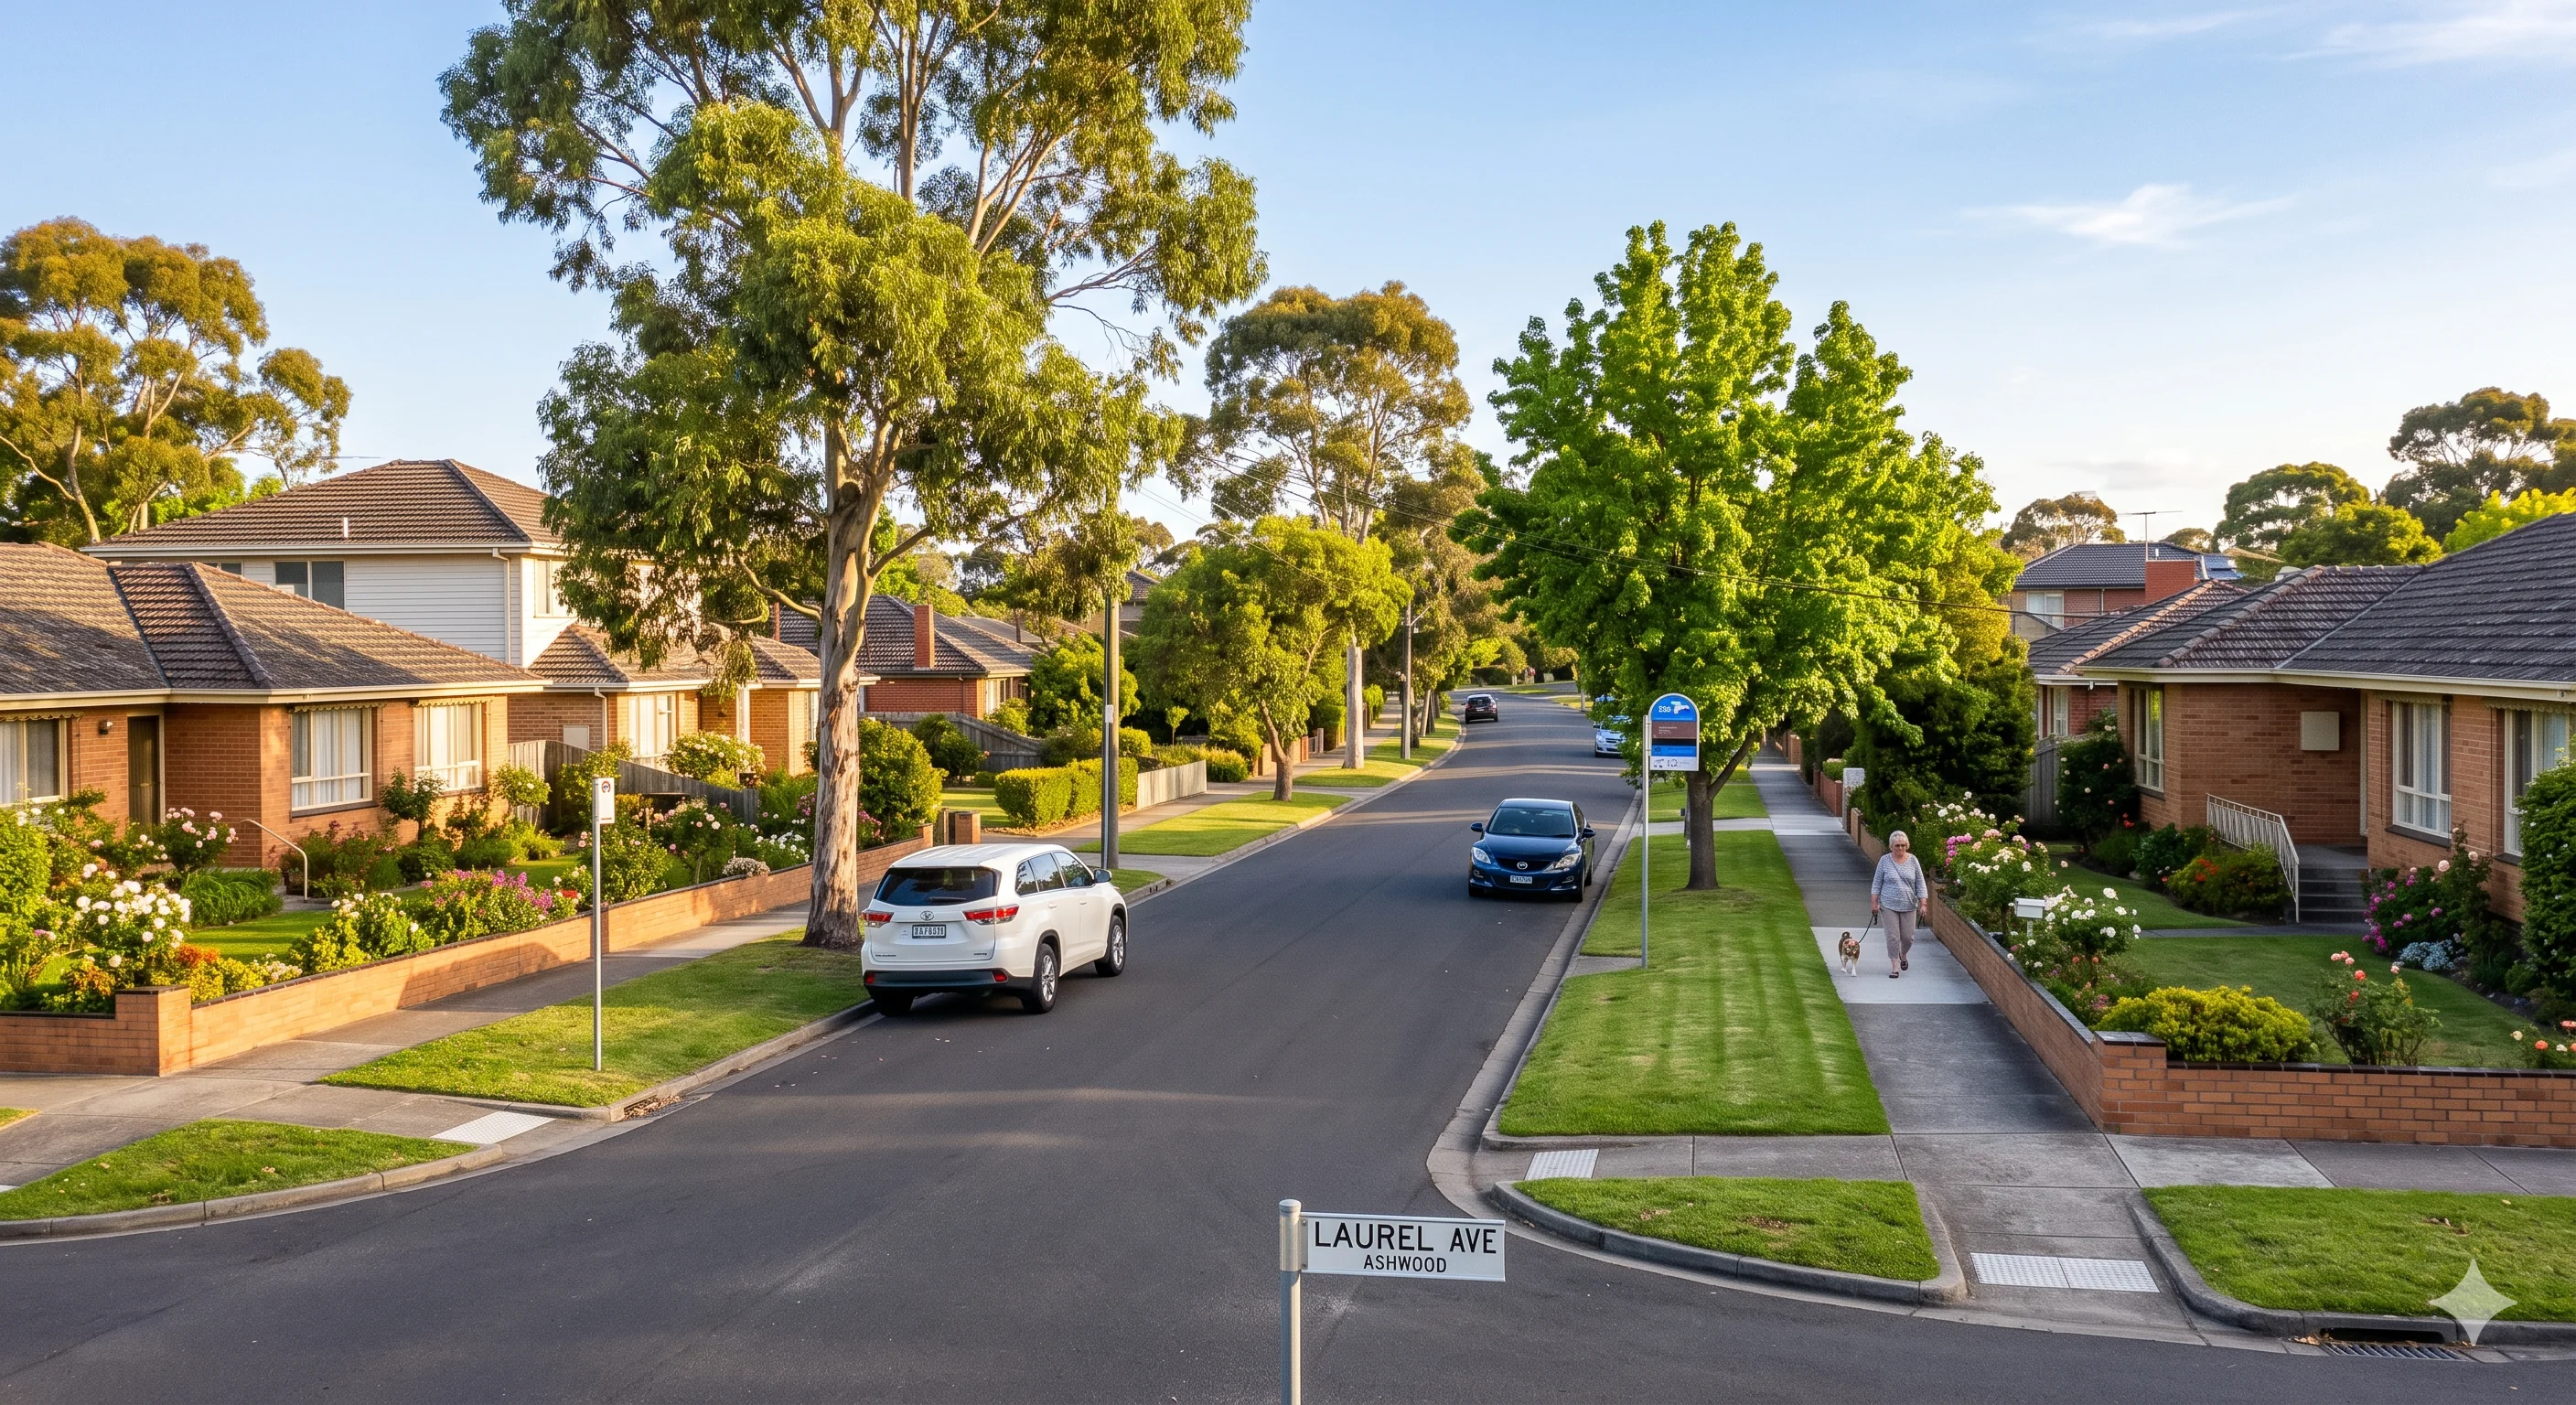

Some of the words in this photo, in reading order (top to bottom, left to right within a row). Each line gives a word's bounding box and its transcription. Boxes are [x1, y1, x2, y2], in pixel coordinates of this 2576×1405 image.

[1315, 1221, 1434, 1252] LAUREL
[1449, 1228, 1497, 1254] AVE
[1363, 1254, 1447, 1273] ASHWOOD
